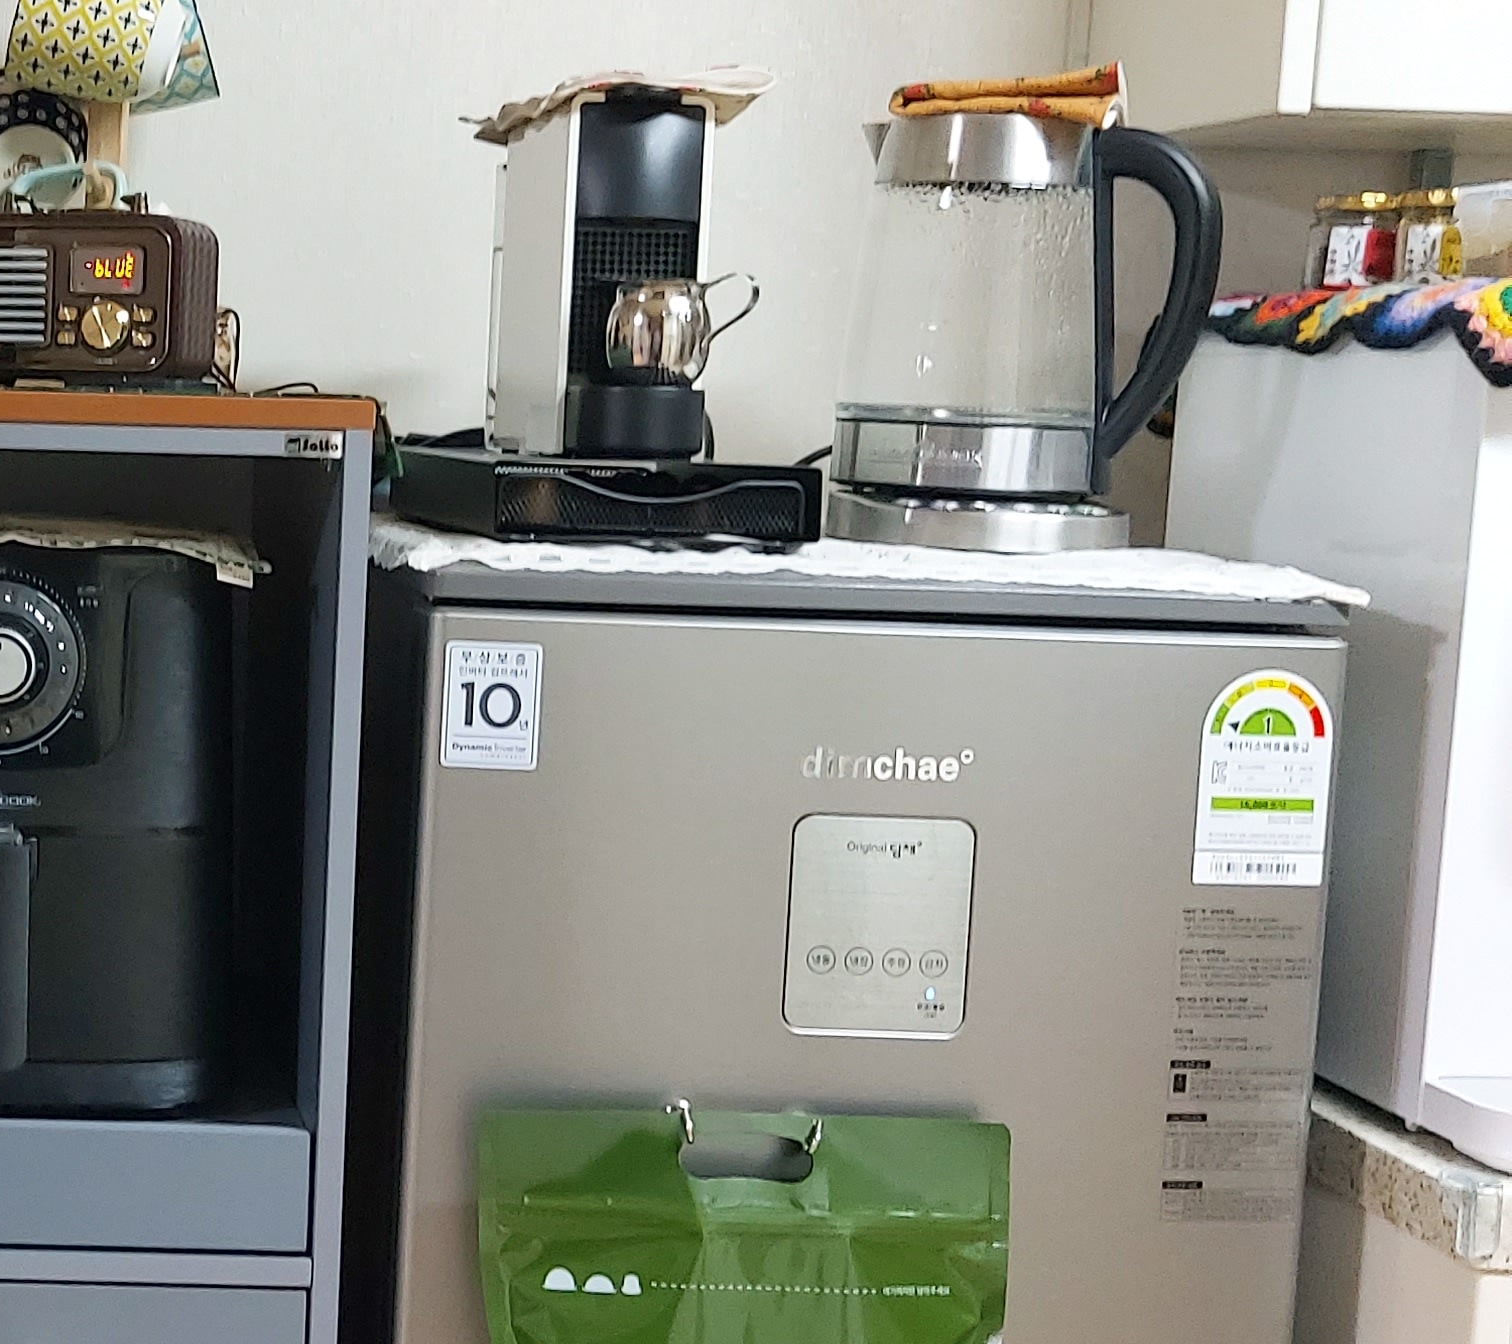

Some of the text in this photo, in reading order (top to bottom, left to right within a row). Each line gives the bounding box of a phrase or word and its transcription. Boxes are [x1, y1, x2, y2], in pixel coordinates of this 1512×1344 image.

[460, 682, 522, 728] 10
[451, 742, 492, 753] Dynamic
[847, 840, 887, 855] Original
